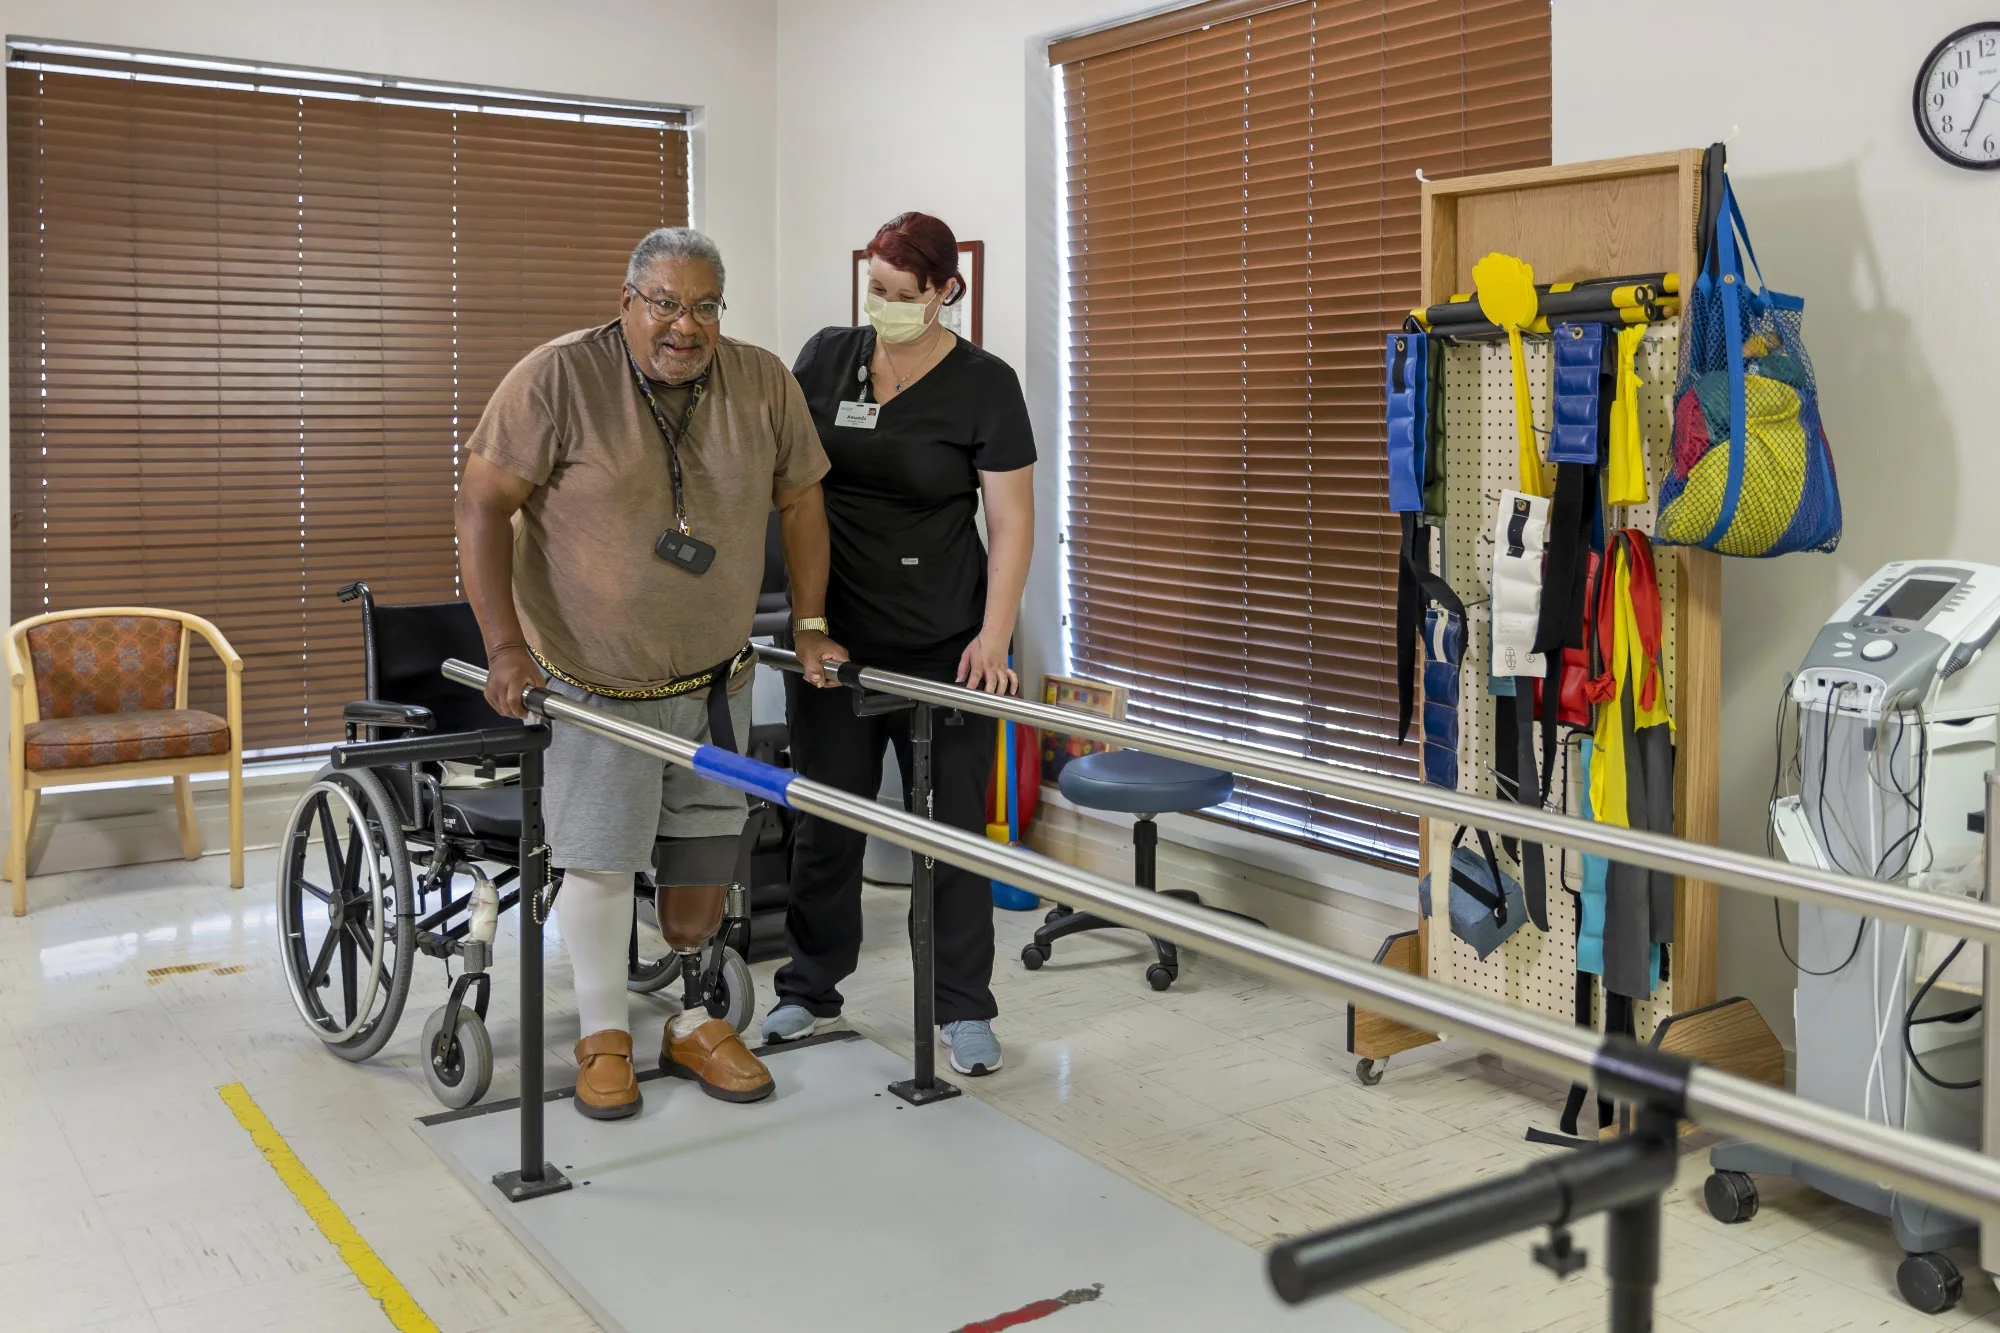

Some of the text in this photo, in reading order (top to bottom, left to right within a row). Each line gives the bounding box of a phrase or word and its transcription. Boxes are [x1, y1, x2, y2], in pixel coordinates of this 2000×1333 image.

[1976, 38, 1996, 58] 12
[1957, 50, 1972, 70] 11
[1940, 70, 1959, 90] 10
[1933, 93, 1944, 112] 9
[1942, 115, 1953, 134] 8
[1960, 129, 1971, 148] 7
[1983, 134, 1995, 153] 6
